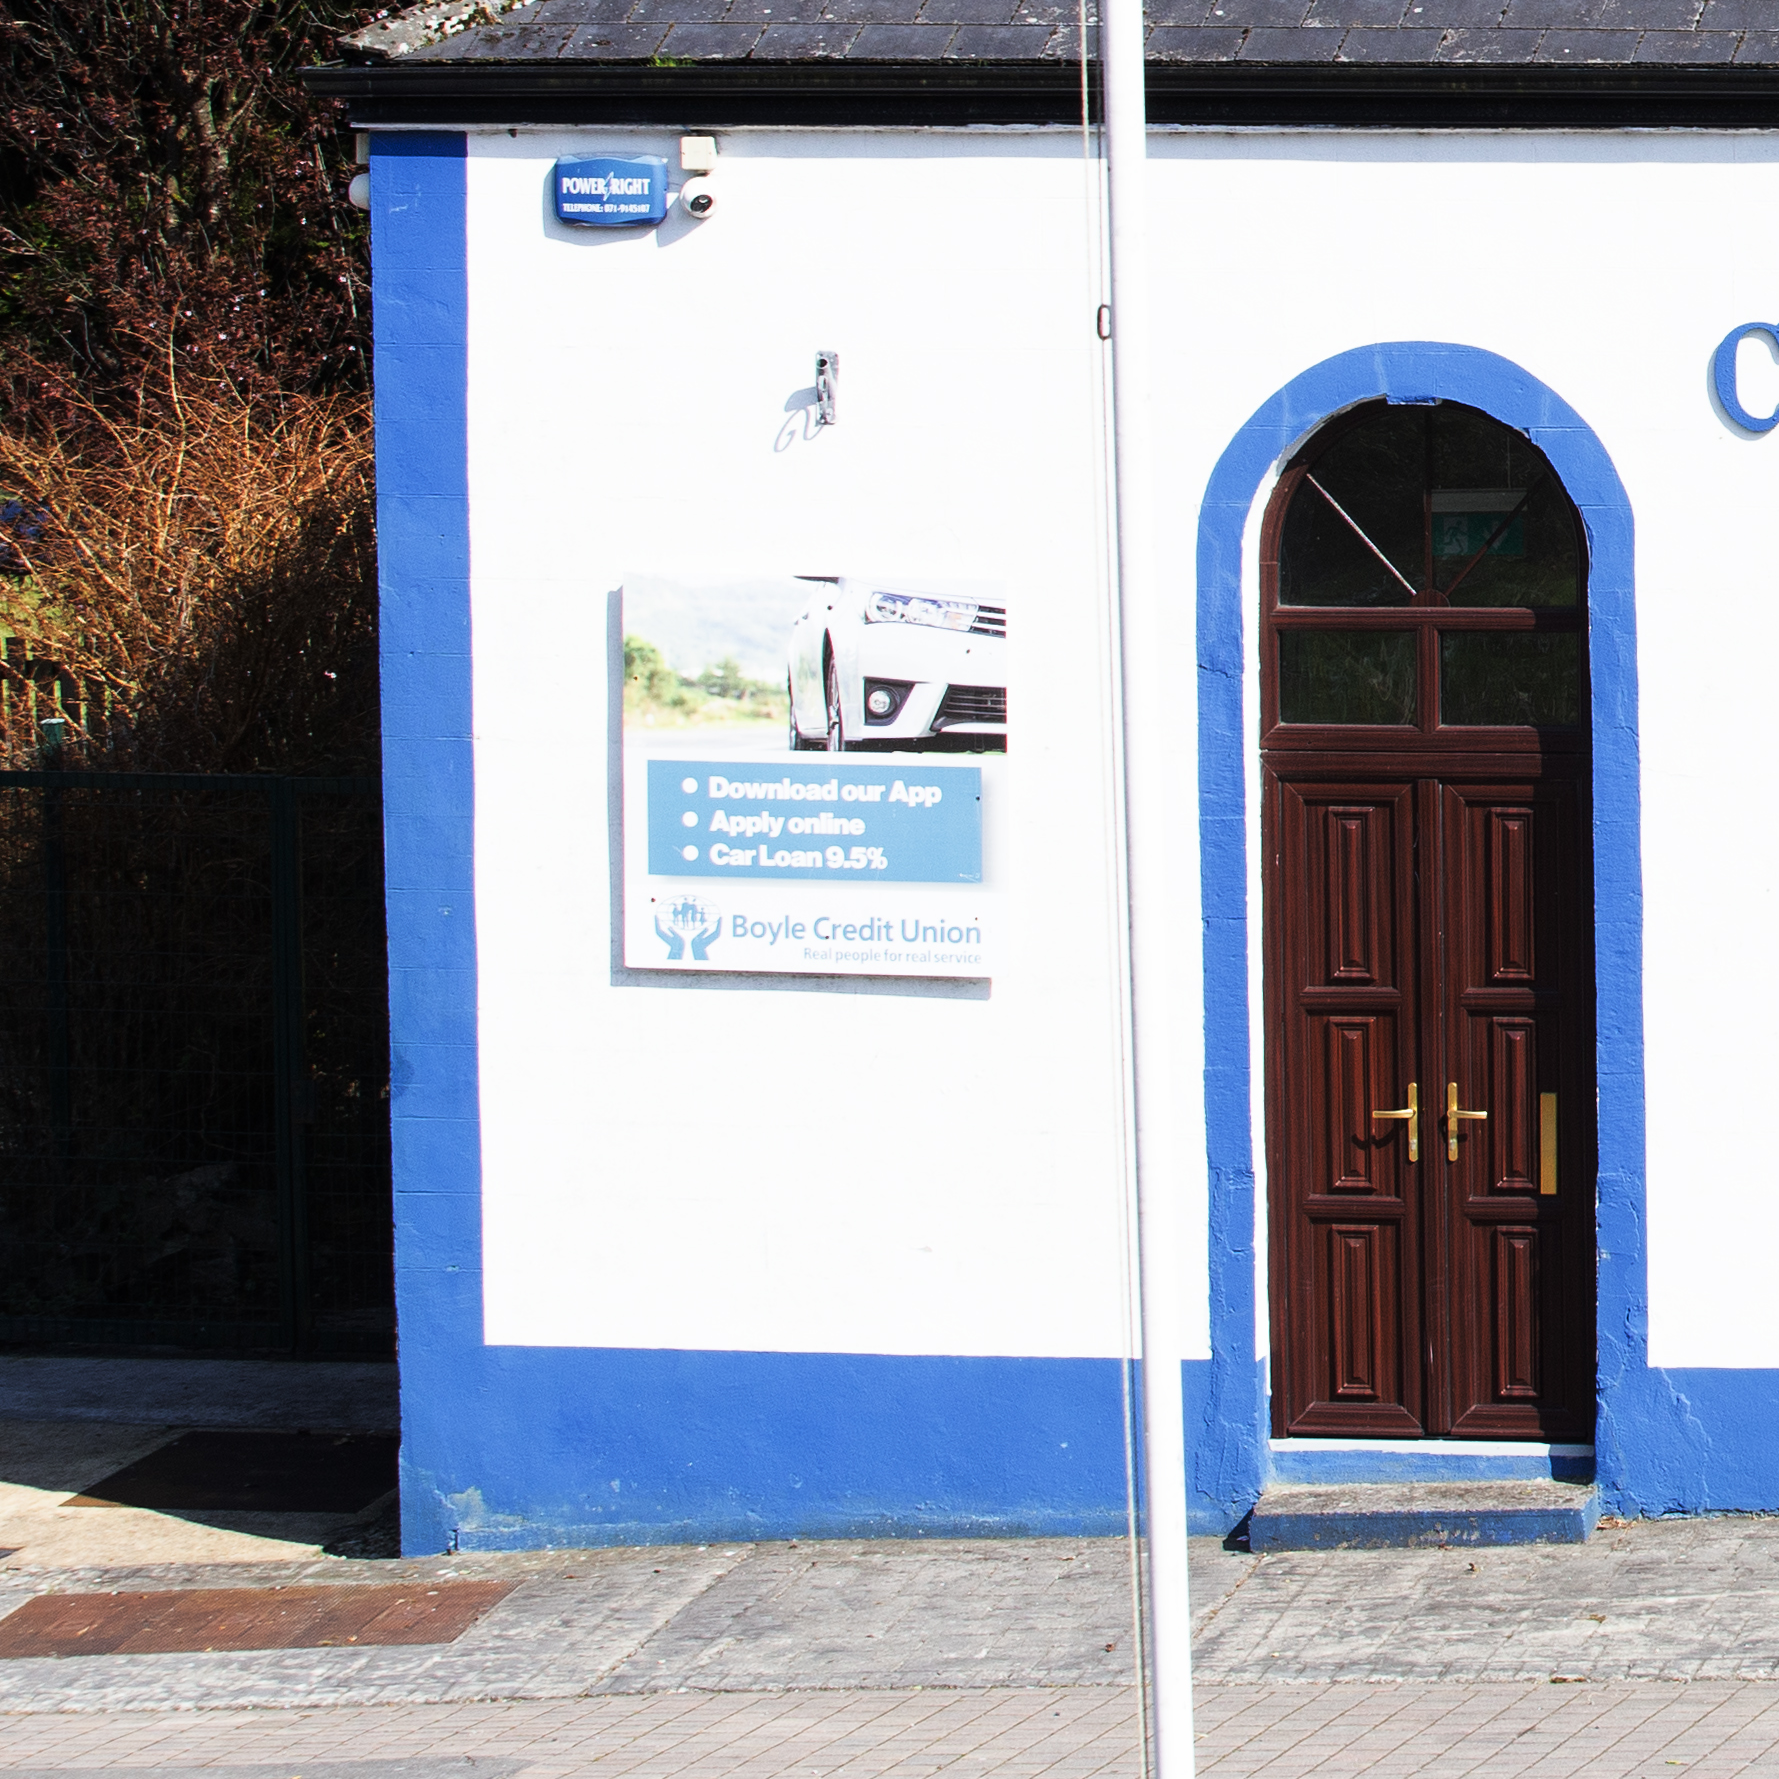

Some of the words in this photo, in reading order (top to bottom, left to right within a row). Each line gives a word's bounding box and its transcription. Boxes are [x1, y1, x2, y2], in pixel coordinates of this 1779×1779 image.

[561, 177, 606, 195] POWER
[611, 178, 650, 195] RIGHT
[708, 775, 838, 802] Download
[840, 783, 886, 802] our
[888, 780, 943, 808] App
[709, 809, 786, 838] Apply
[787, 811, 867, 836] online
[709, 843, 757, 866] Car
[759, 844, 824, 869] Loan
[825, 845, 889, 871] 9.5%
[731, 914, 806, 946] Boyle
[813, 915, 893, 942] Credit
[901, 918, 982, 944] Union
[803, 948, 833, 961] Real
[835, 949, 882, 965] people
[884, 948, 903, 962] for
[905, 949, 932, 963] real
[934, 951, 982, 965] service
